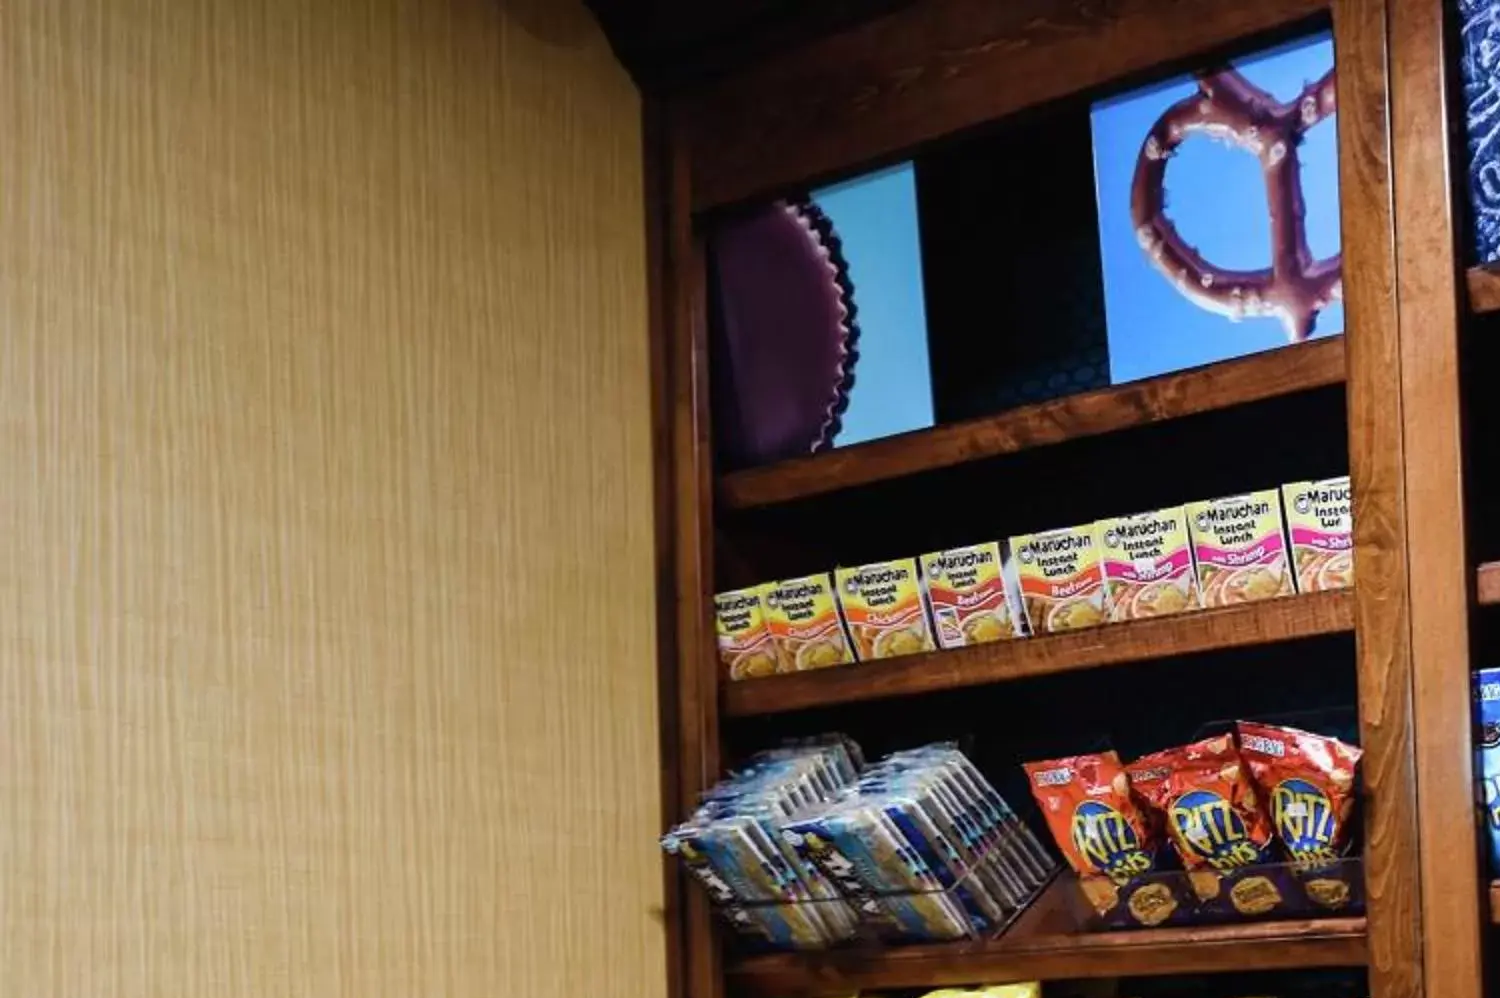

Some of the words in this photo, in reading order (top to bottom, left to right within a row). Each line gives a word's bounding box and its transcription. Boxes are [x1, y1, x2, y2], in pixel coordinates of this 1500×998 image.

[1207, 501, 1269, 523] Maruchan
[1115, 518, 1177, 539] Maruchan
[1213, 520, 1257, 535] Instant
[1030, 534, 1091, 553] Maruchan
[1123, 537, 1165, 551] Instant
[1220, 532, 1254, 545] Lunch
[936, 551, 993, 570] Maruchan
[1037, 552, 1079, 567] Instant
[1129, 547, 1162, 560] Lunch
[854, 569, 908, 586] Maruchan
[1043, 564, 1077, 578] Lunch
